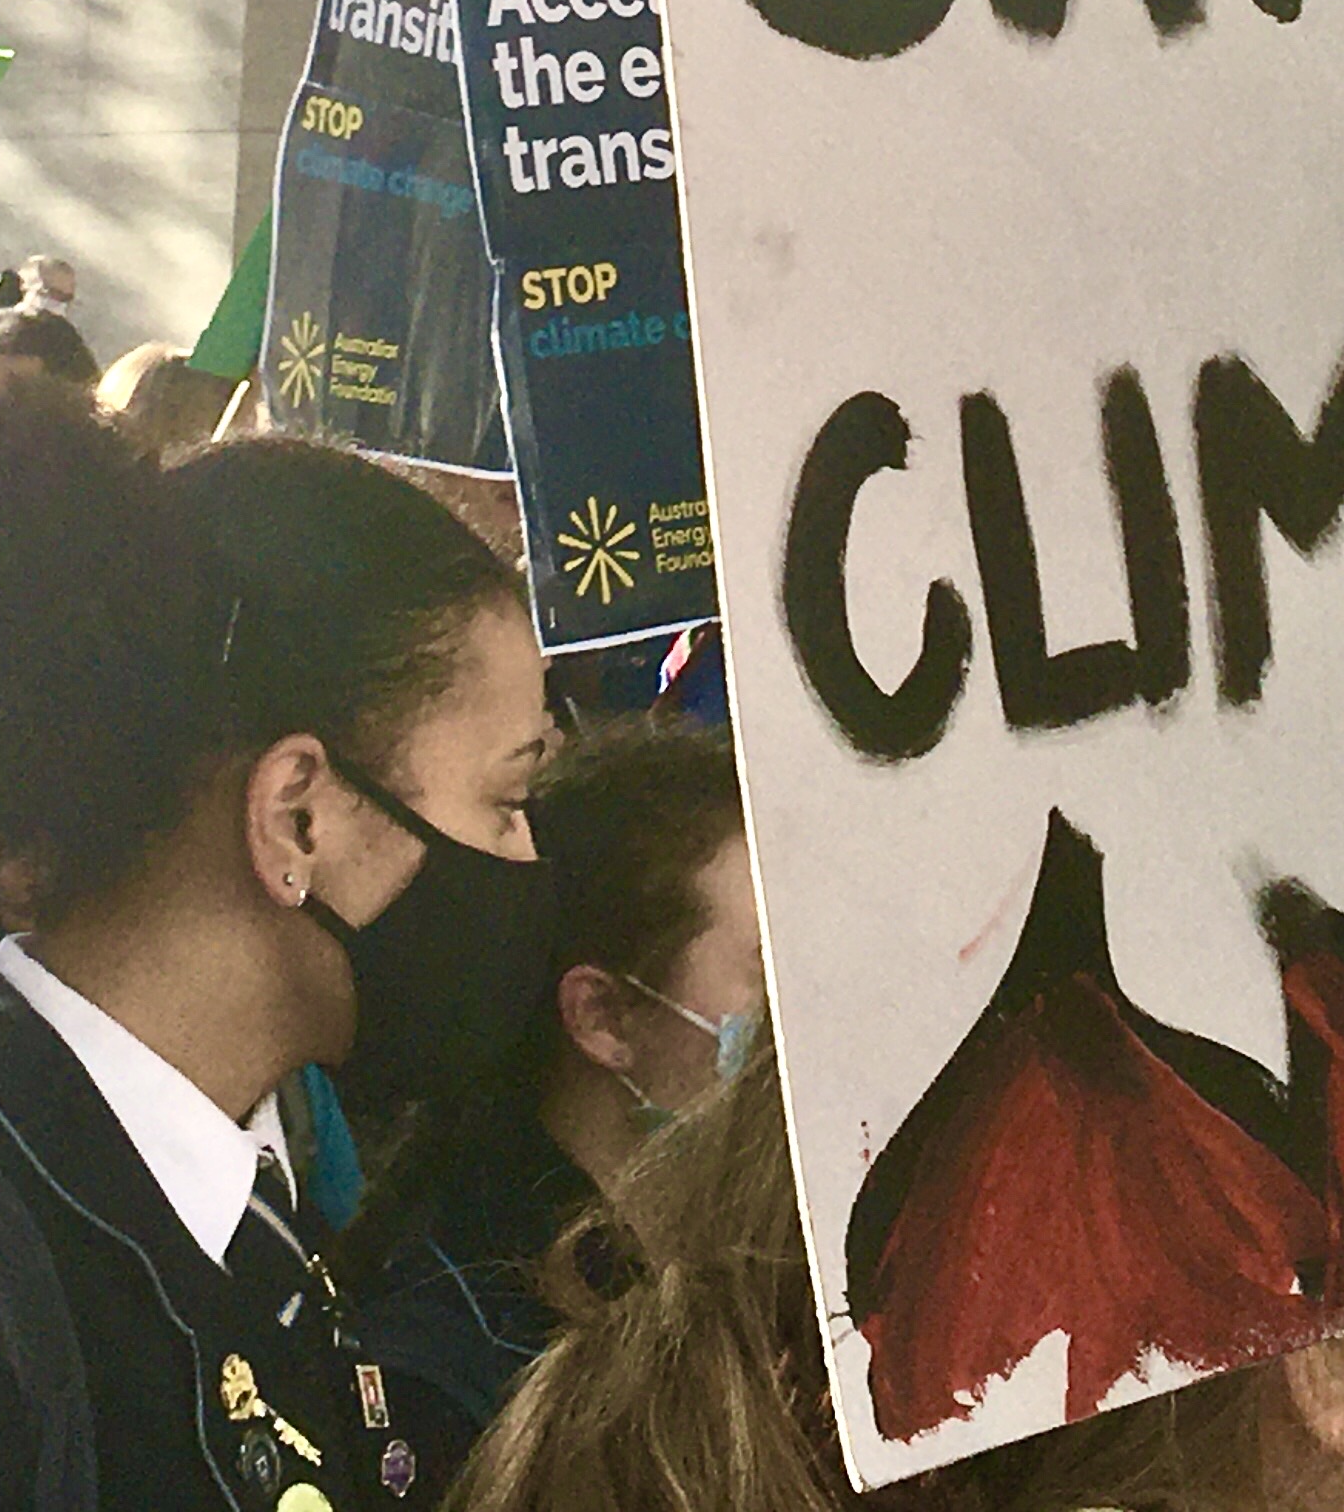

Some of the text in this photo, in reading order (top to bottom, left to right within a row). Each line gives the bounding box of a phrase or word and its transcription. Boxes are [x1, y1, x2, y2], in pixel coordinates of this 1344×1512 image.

[492, 36, 605, 109] the
[302, 96, 363, 139] STOP
[503, 126, 676, 194] trans
[522, 262, 617, 310] STOP
[529, 309, 666, 359] climate
